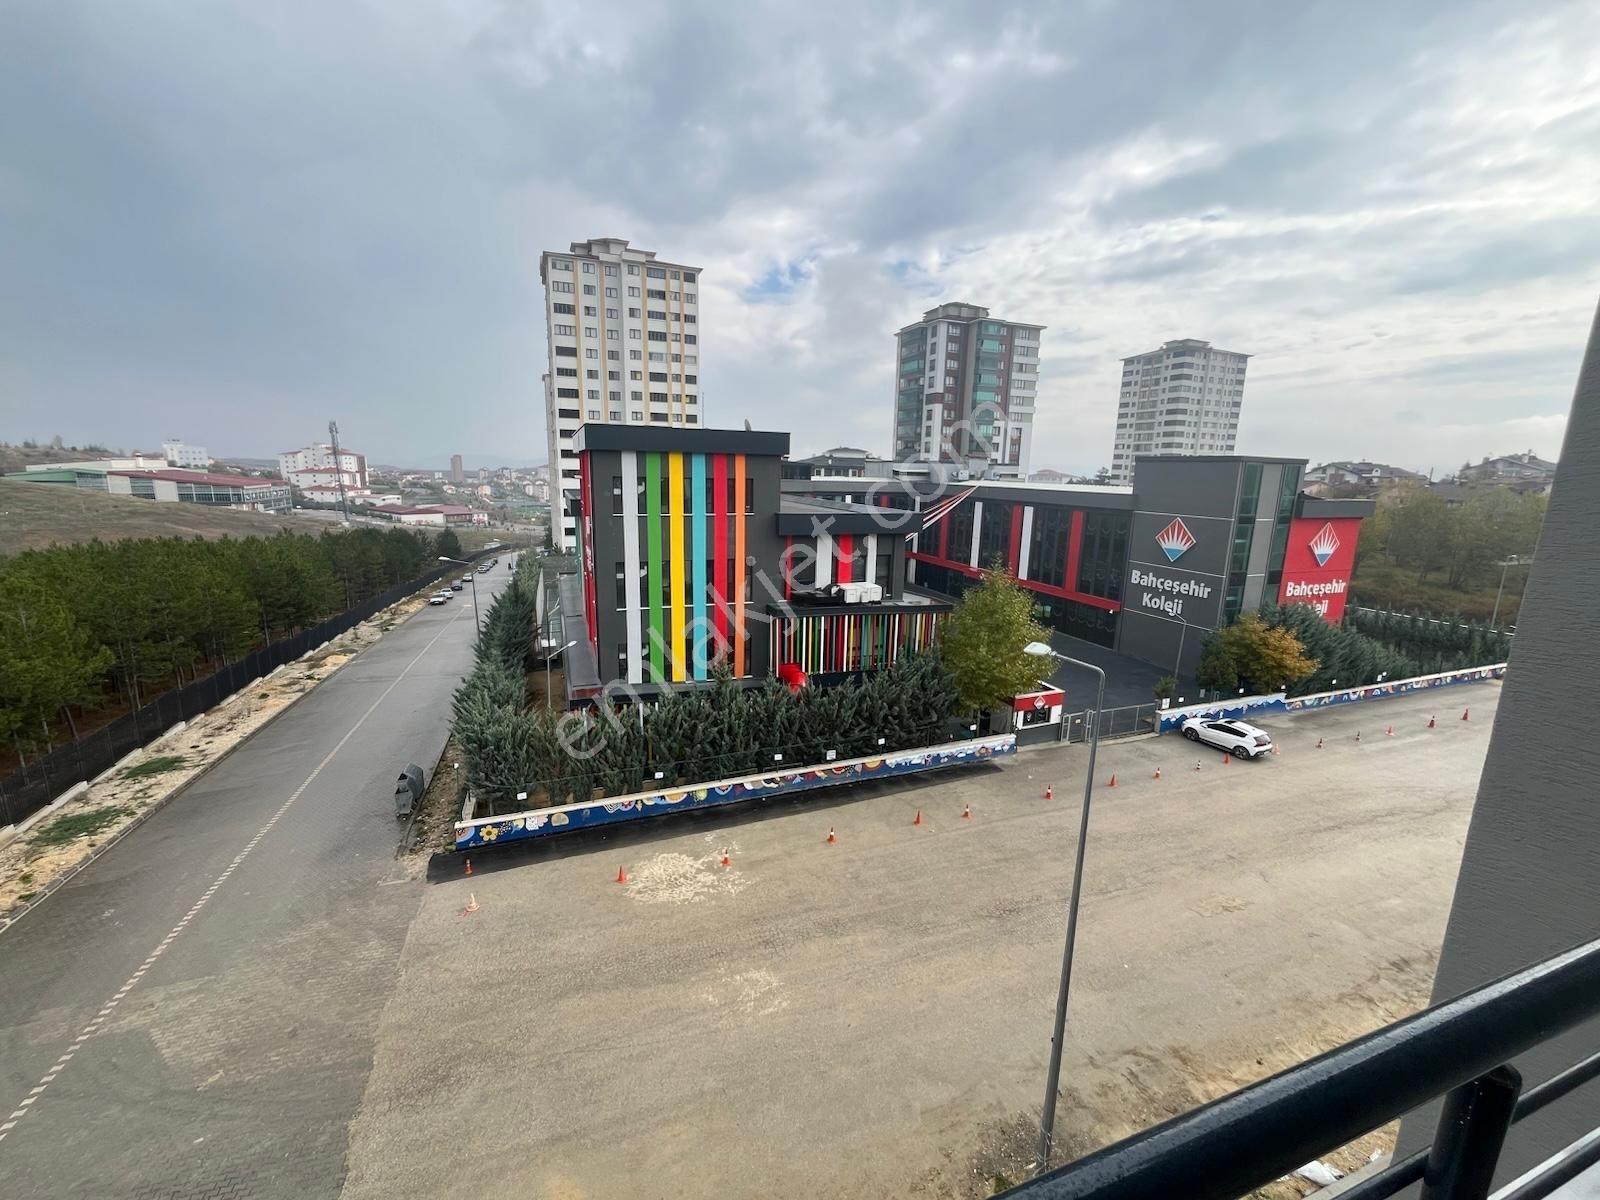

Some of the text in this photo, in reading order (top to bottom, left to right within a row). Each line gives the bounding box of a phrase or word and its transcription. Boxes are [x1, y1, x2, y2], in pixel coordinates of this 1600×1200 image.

[1131, 569, 1212, 599] Bahçeşehir
[1286, 578, 1346, 598] Bahçeşehir
[1142, 592, 1183, 617] Koleji
